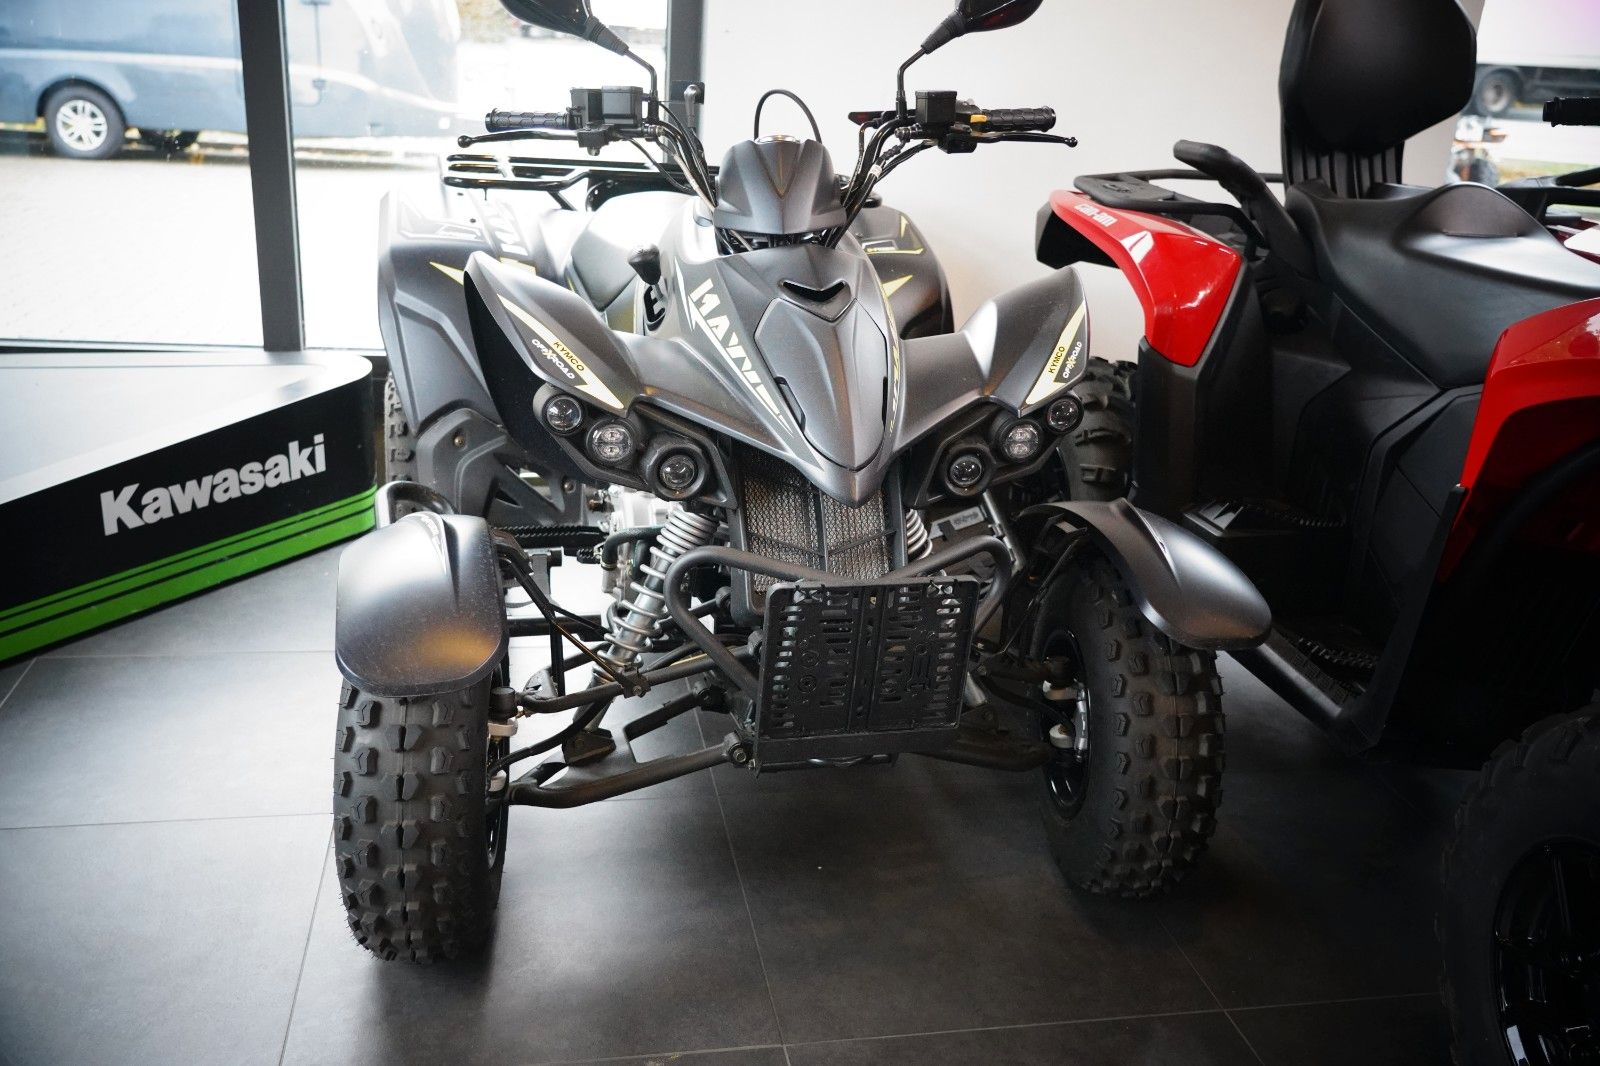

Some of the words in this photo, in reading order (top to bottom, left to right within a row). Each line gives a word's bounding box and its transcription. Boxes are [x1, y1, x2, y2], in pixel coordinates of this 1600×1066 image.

[552, 341, 585, 372] KYMCO
[1048, 346, 1065, 374] KYMCO
[100, 433, 327, 536] Kawasaki
